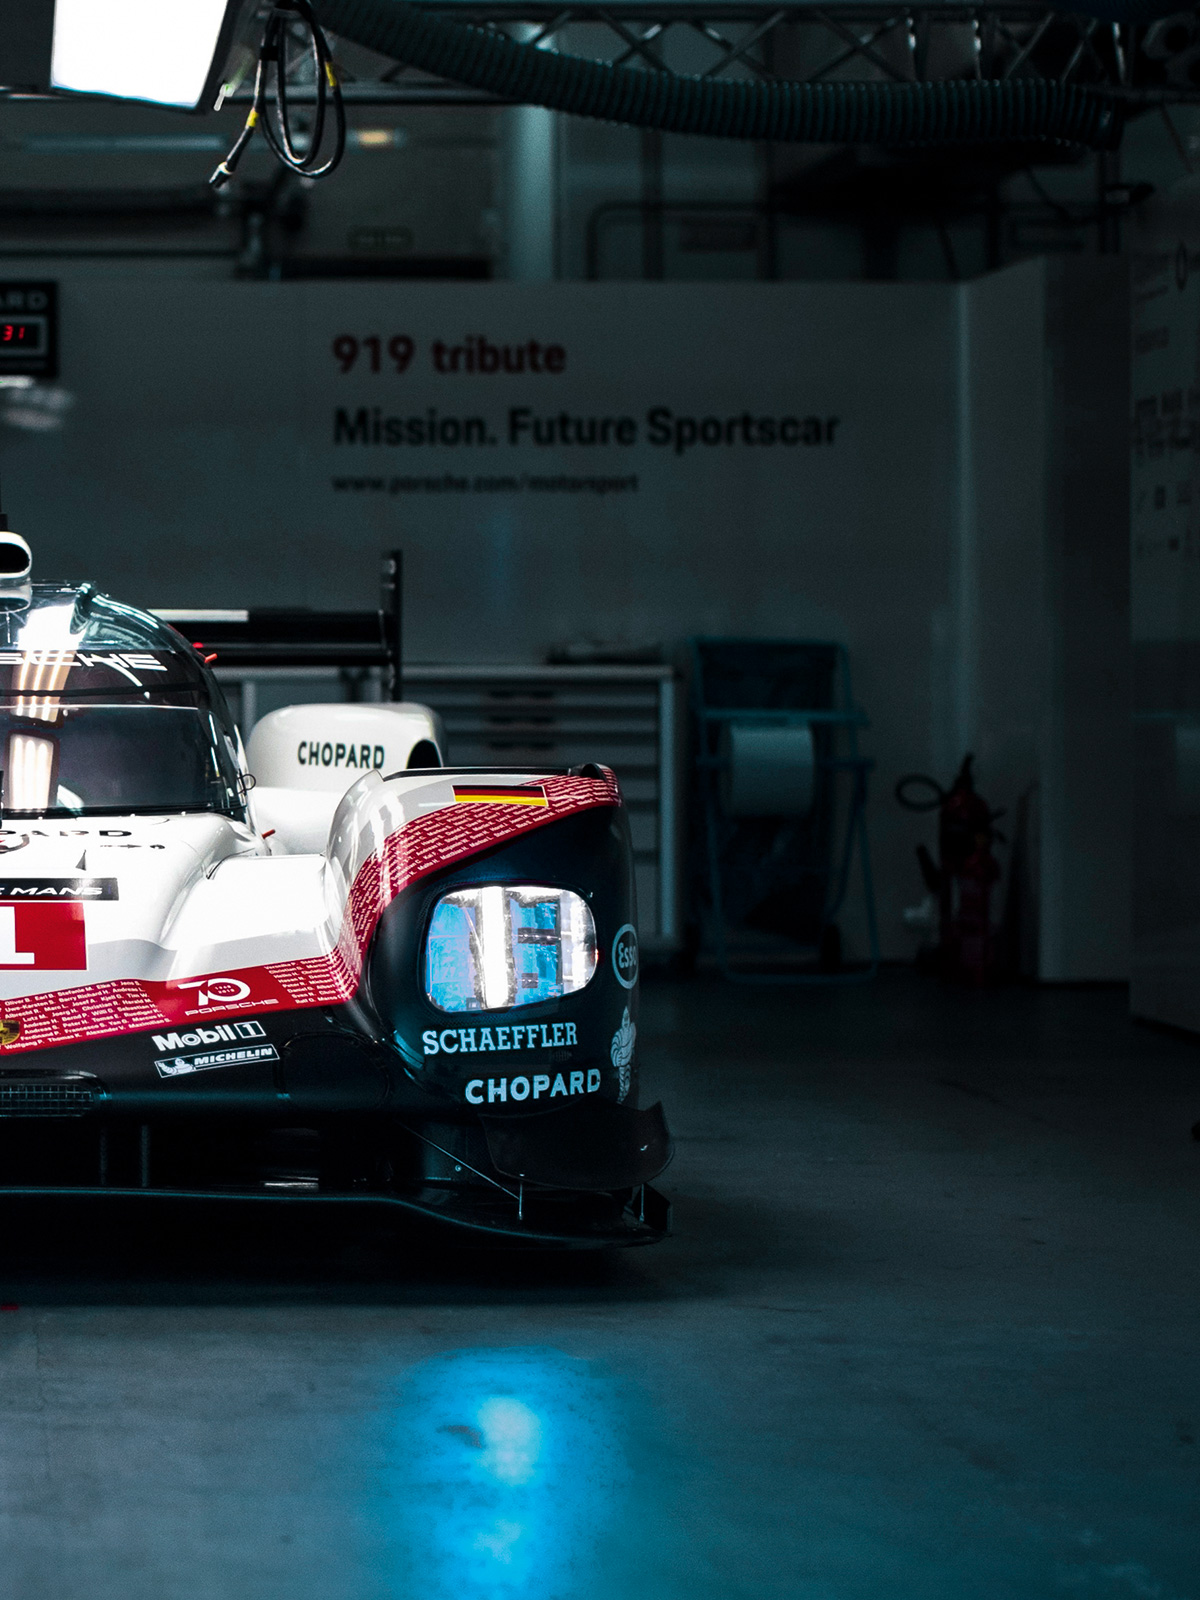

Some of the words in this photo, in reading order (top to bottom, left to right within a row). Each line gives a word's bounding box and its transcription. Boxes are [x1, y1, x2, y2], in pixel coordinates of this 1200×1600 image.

[332, 334, 415, 374] 919
[432, 333, 566, 374] tribute
[334, 406, 498, 446] Mission.
[508, 406, 636, 446] Future
[647, 405, 840, 456] Sportscar
[298, 741, 385, 770] CHOPARD
[10, 887, 103, 896] MANS
[177, 978, 251, 1006] 70
[185, 998, 280, 1017] PORSCHE
[152, 1024, 238, 1051] Mobil
[422, 1022, 579, 1055] SCHAEFFLER
[193, 1047, 273, 1066] MICHELIN
[464, 1068, 602, 1105] CHOPARD
